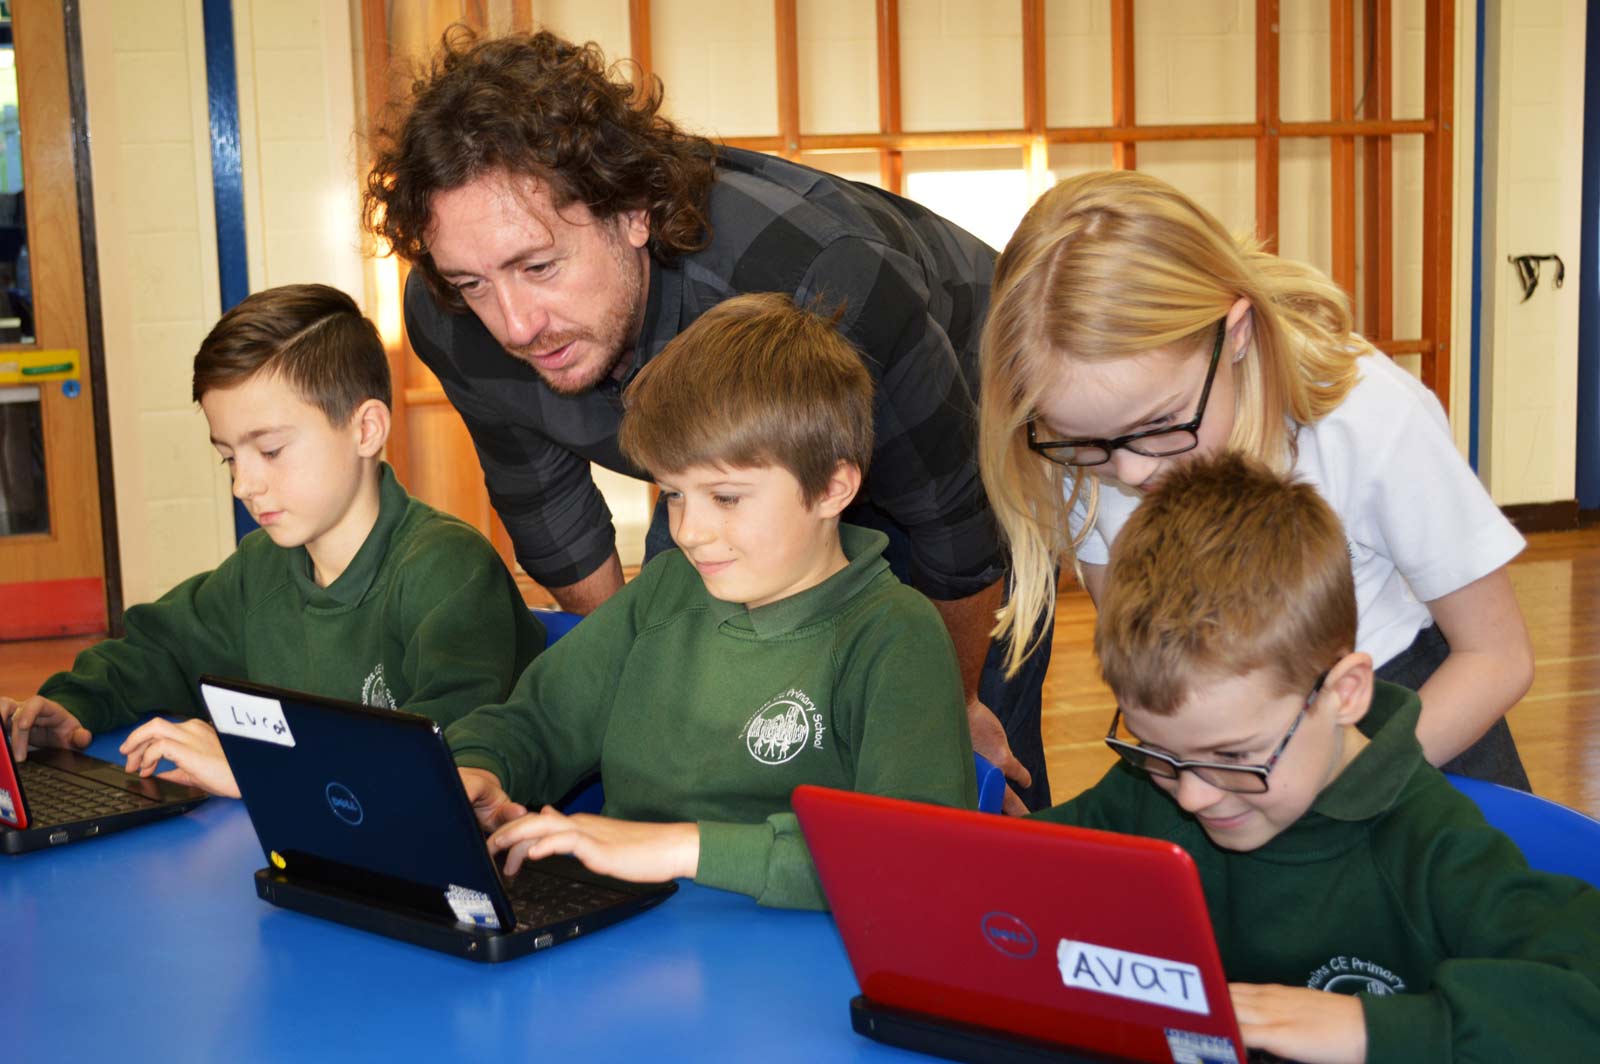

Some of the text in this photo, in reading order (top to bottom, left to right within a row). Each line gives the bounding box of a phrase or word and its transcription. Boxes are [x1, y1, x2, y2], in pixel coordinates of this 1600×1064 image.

[812, 713, 826, 750] School
[331, 796, 358, 811] DELL
[988, 927, 1030, 945] DELL
[1330, 956, 1349, 970] CE
[1351, 957, 1406, 989] Primary
